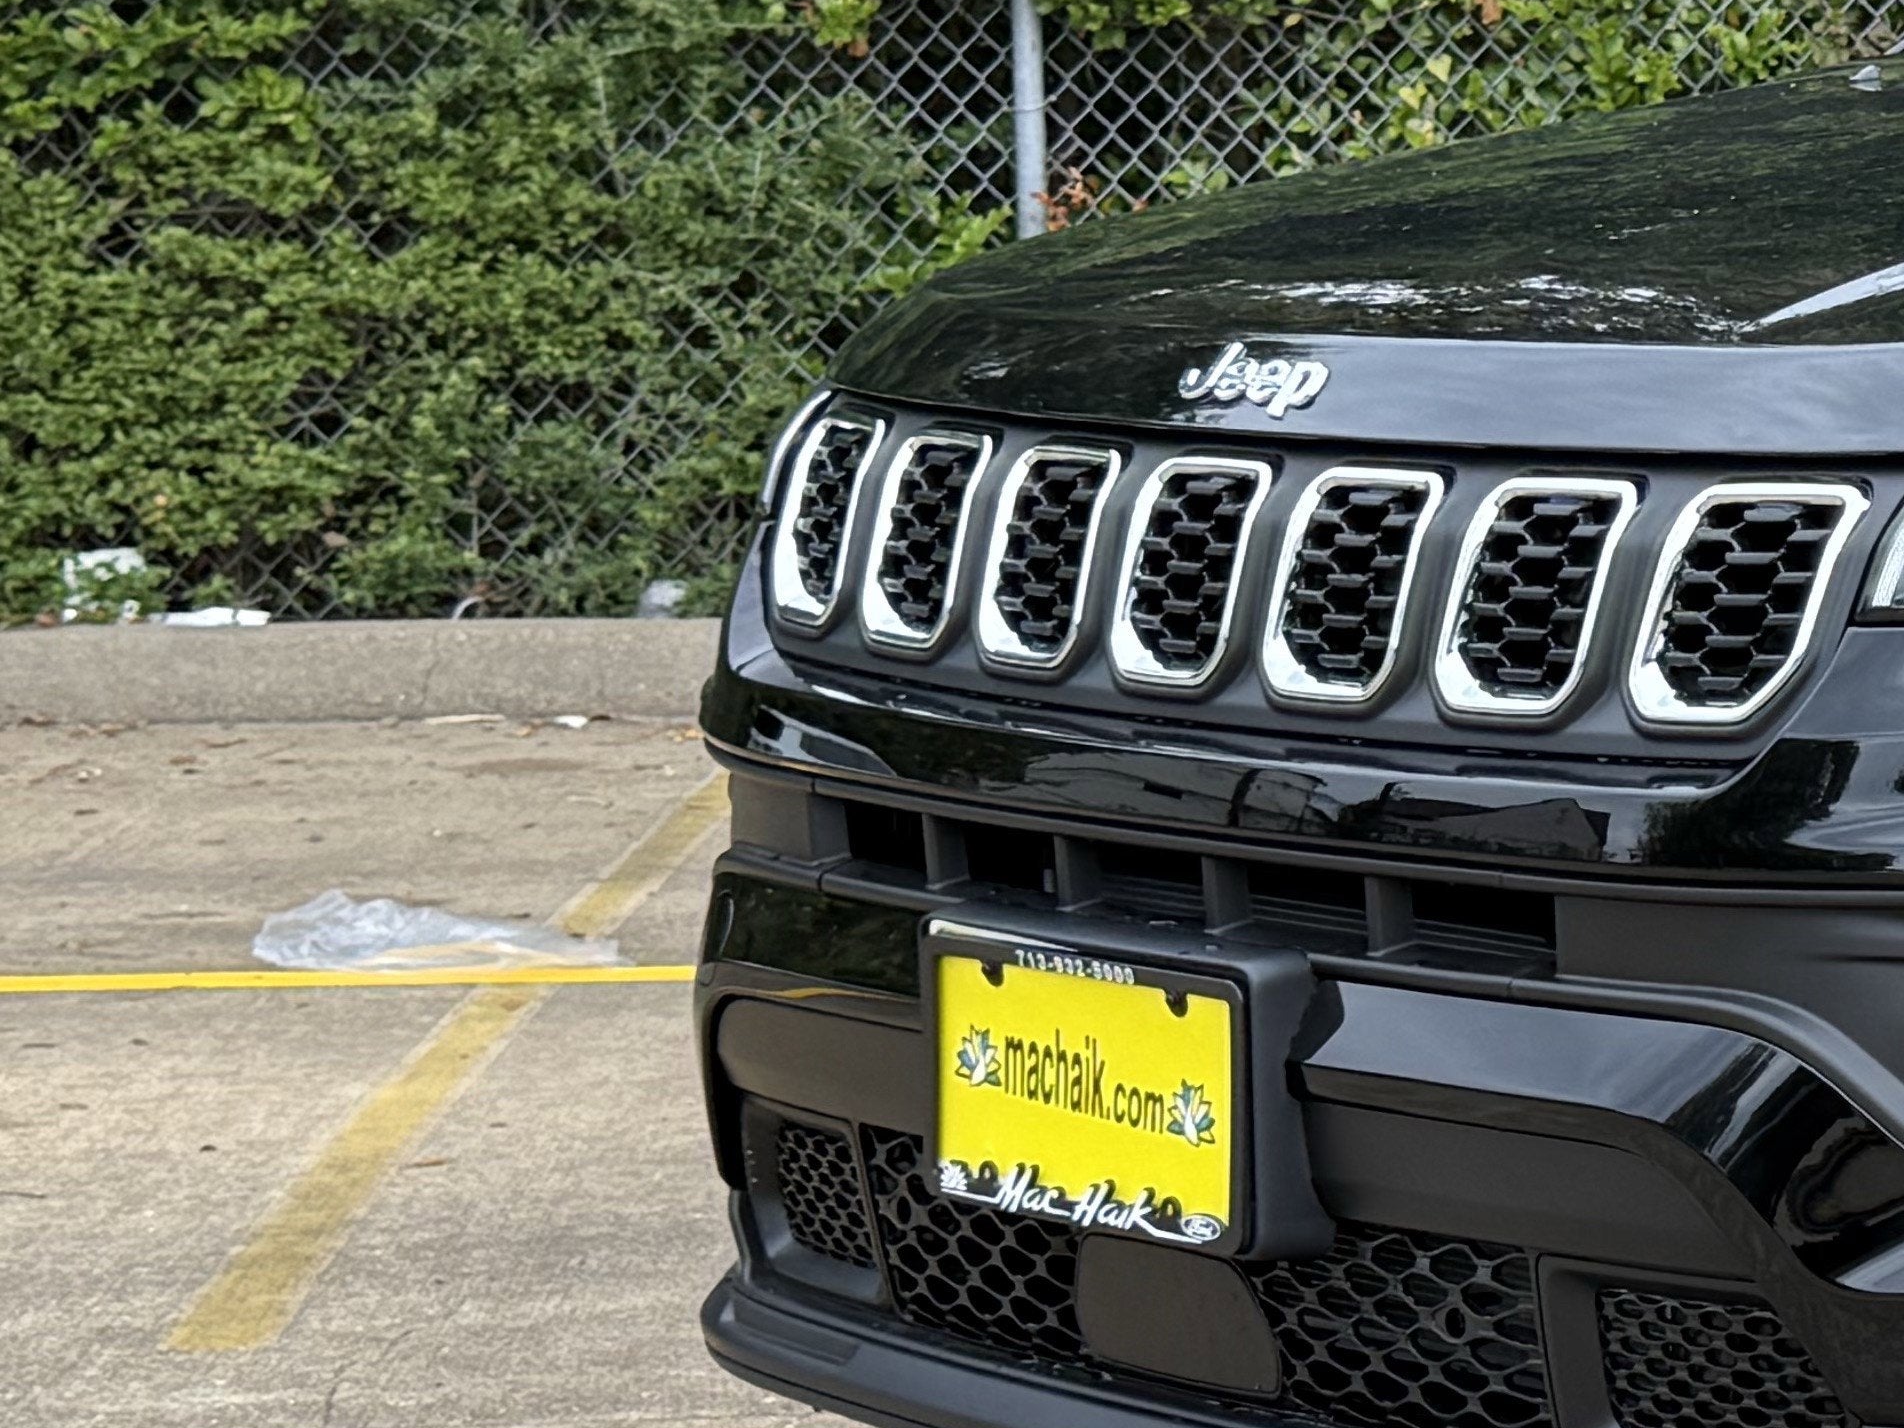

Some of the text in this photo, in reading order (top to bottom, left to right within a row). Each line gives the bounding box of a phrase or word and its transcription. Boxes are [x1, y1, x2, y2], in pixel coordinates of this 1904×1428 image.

[1178, 340, 1330, 419] Jeep
[1004, 1027, 1164, 1135] machaik.com
[999, 1164, 1071, 1215] Mac
